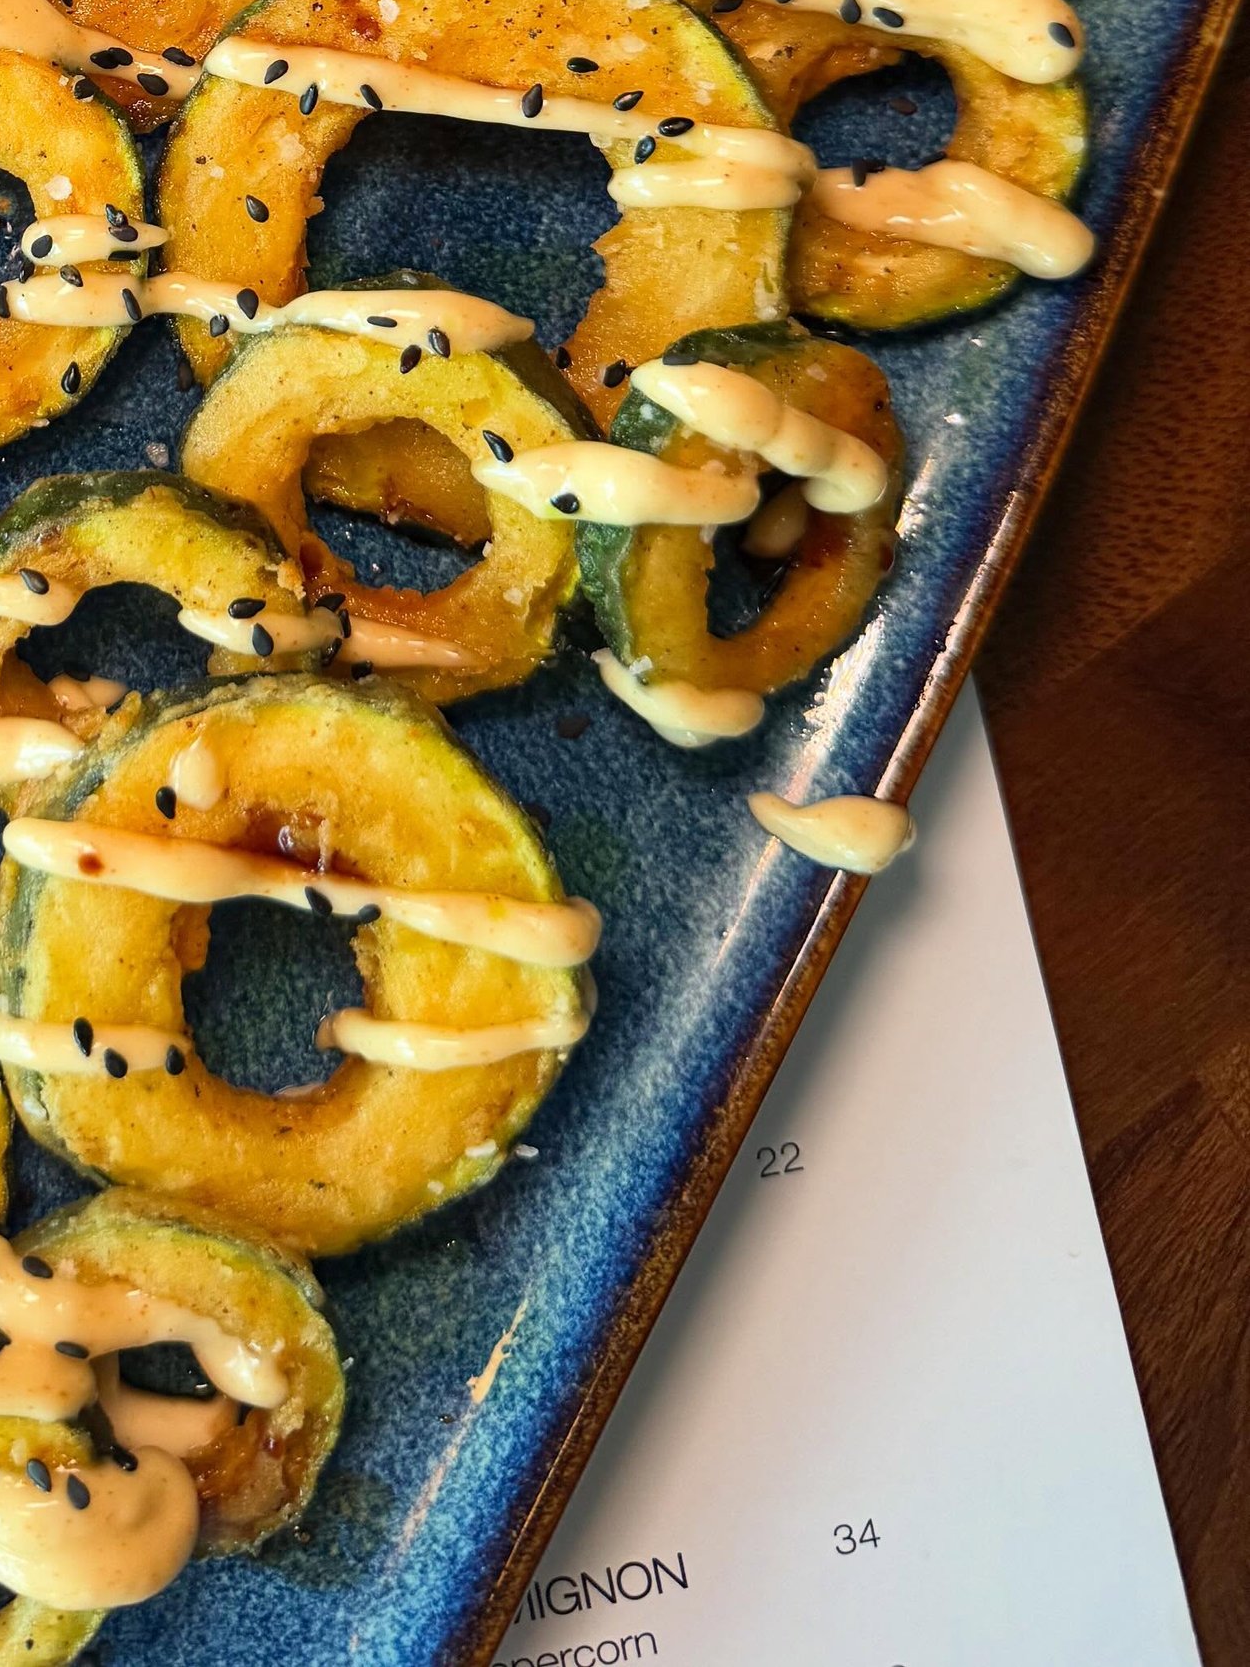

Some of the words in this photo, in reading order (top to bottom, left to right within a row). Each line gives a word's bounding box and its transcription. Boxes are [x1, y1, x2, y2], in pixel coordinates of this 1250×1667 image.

[757, 1142, 804, 1178] 22
[834, 1518, 880, 1555] 34
[492, 1631, 658, 1667] ercorn
